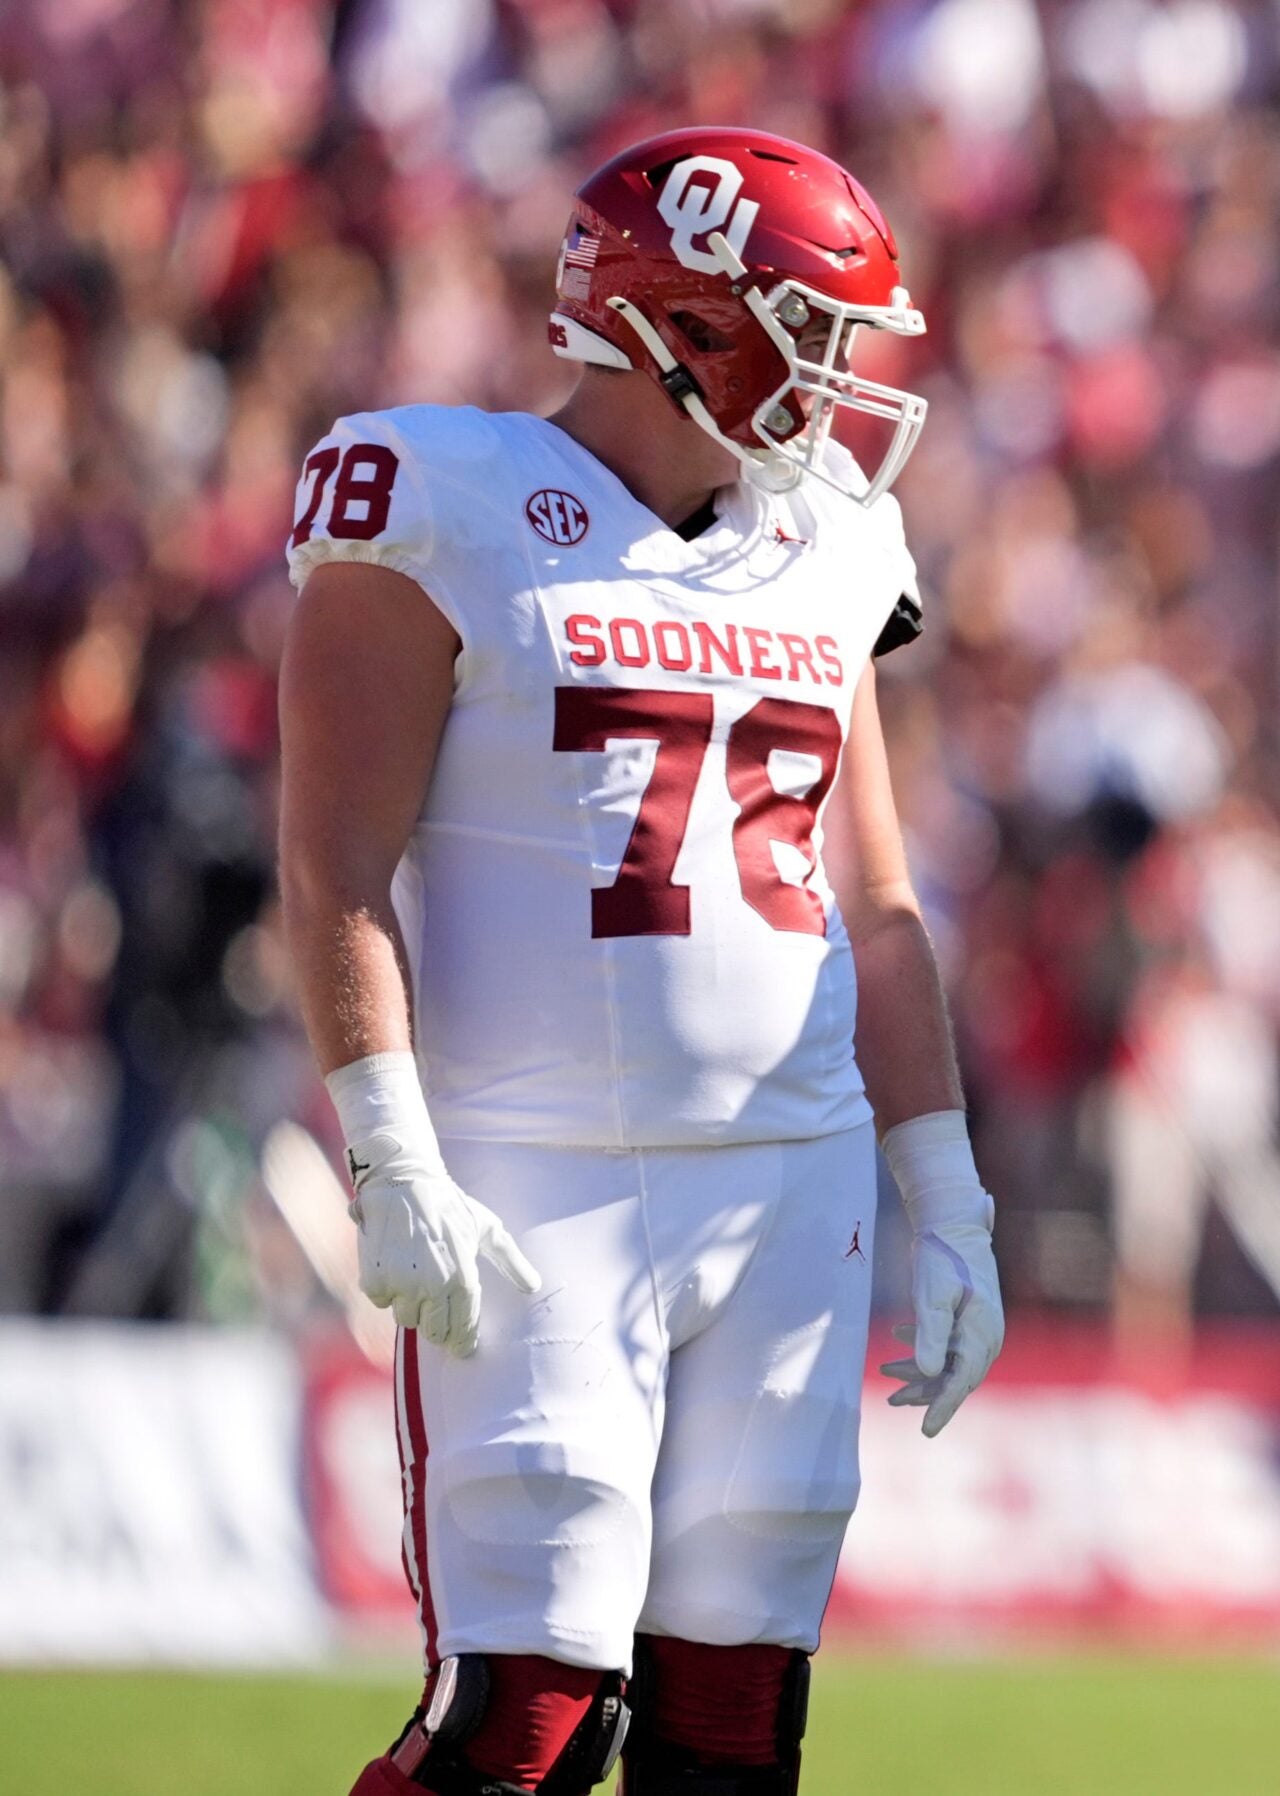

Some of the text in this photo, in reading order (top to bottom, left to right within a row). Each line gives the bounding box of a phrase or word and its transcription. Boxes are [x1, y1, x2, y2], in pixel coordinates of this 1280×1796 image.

[657, 155, 760, 276] OU
[292, 443, 399, 549] 78
[526, 490, 588, 545] SEC
[564, 614, 844, 688] SOONERS
[552, 686, 843, 940] 78
